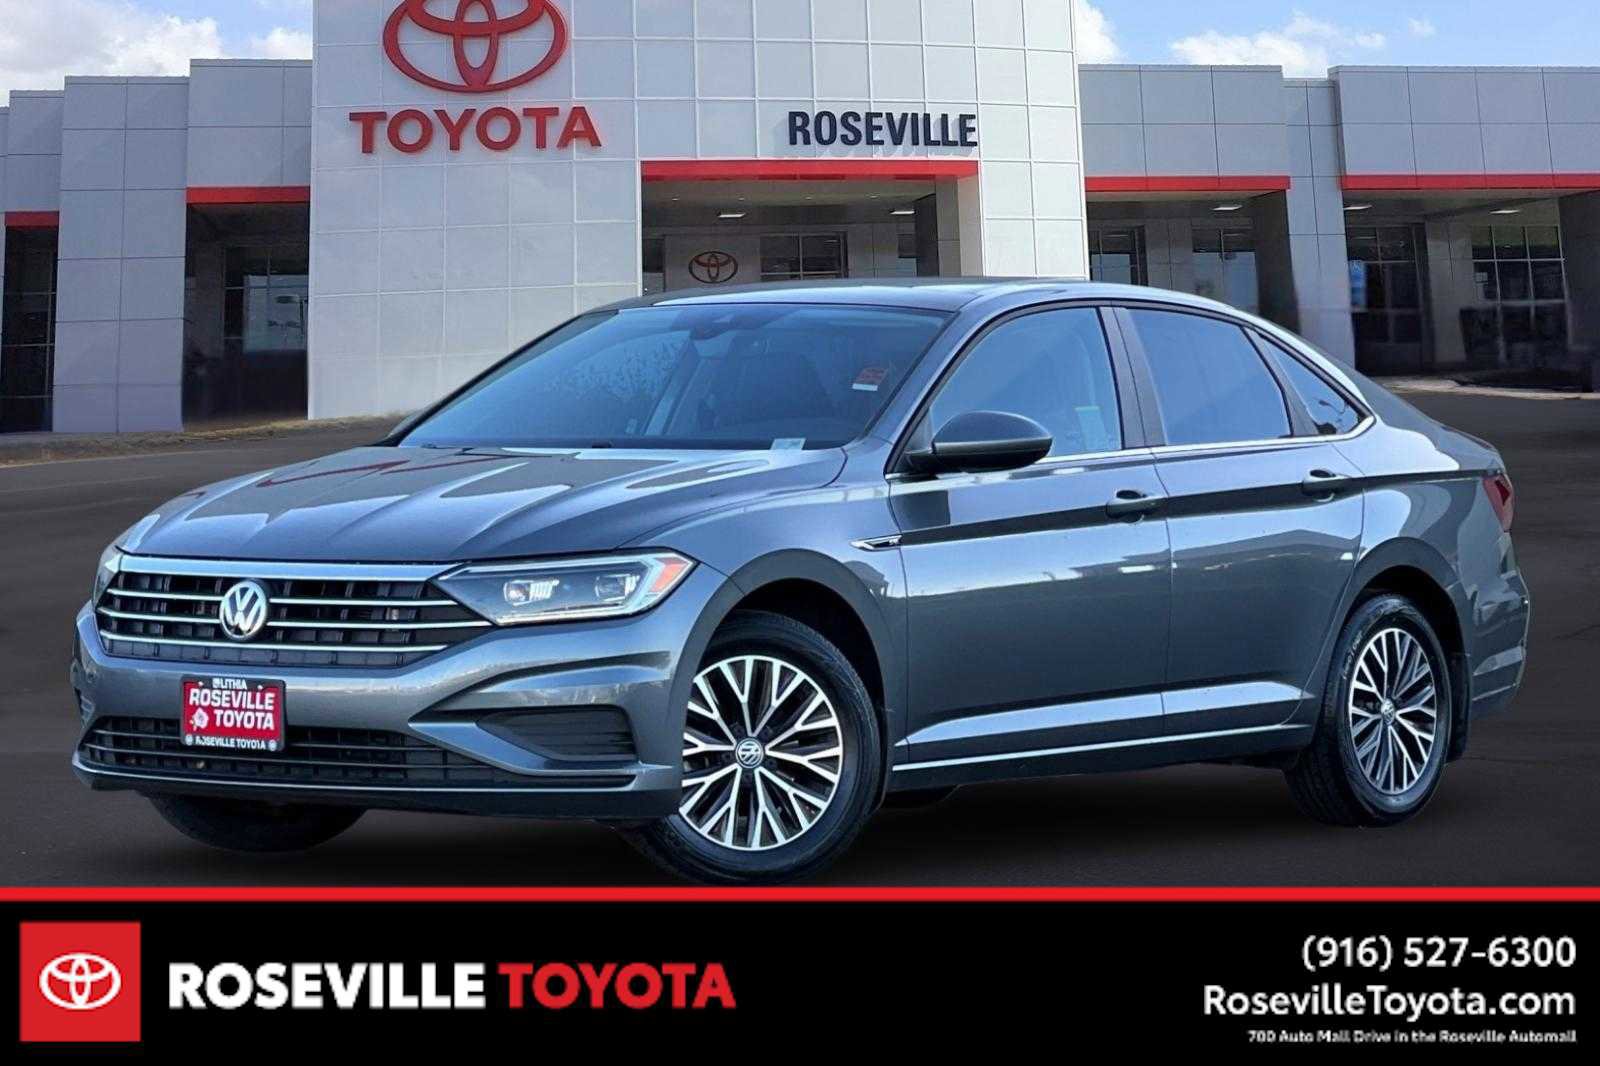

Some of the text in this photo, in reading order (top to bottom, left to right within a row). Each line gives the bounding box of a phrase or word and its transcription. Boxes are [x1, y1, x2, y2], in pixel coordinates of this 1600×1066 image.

[350, 106, 602, 154] TOYOTA
[788, 111, 978, 147] ROSEVILLE
[220, 678, 248, 690] LITHIA
[189, 688, 276, 711] ROSEVILLE
[213, 709, 275, 731] TOYOTA
[236, 739, 266, 750] TOYOTA
